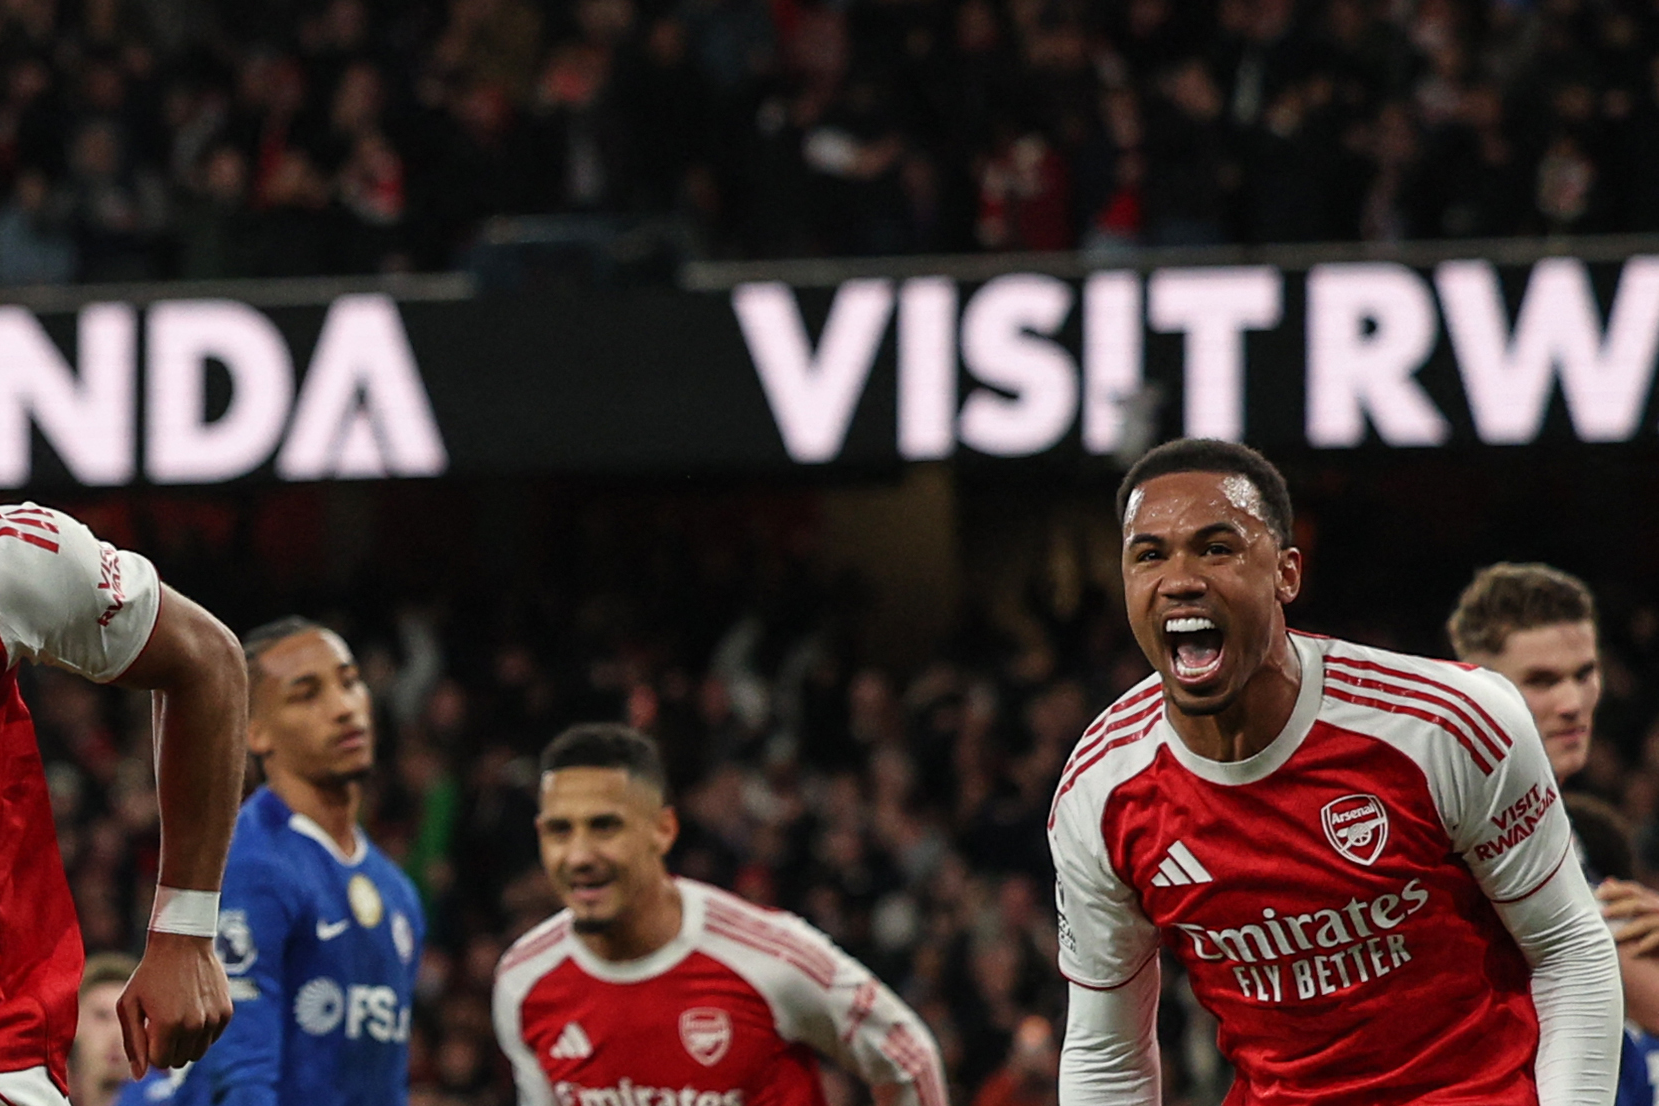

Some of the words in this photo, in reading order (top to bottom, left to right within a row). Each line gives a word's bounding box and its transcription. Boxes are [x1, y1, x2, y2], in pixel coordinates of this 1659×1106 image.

[733, 267, 1282, 463] VISIT
[1331, 802, 1376, 825] Arsenal
[1490, 783, 1541, 831] VISIT
[1171, 878, 1429, 963] Emirates
[1233, 965, 1282, 1003] FLY
[1292, 933, 1412, 1001] BETTER
